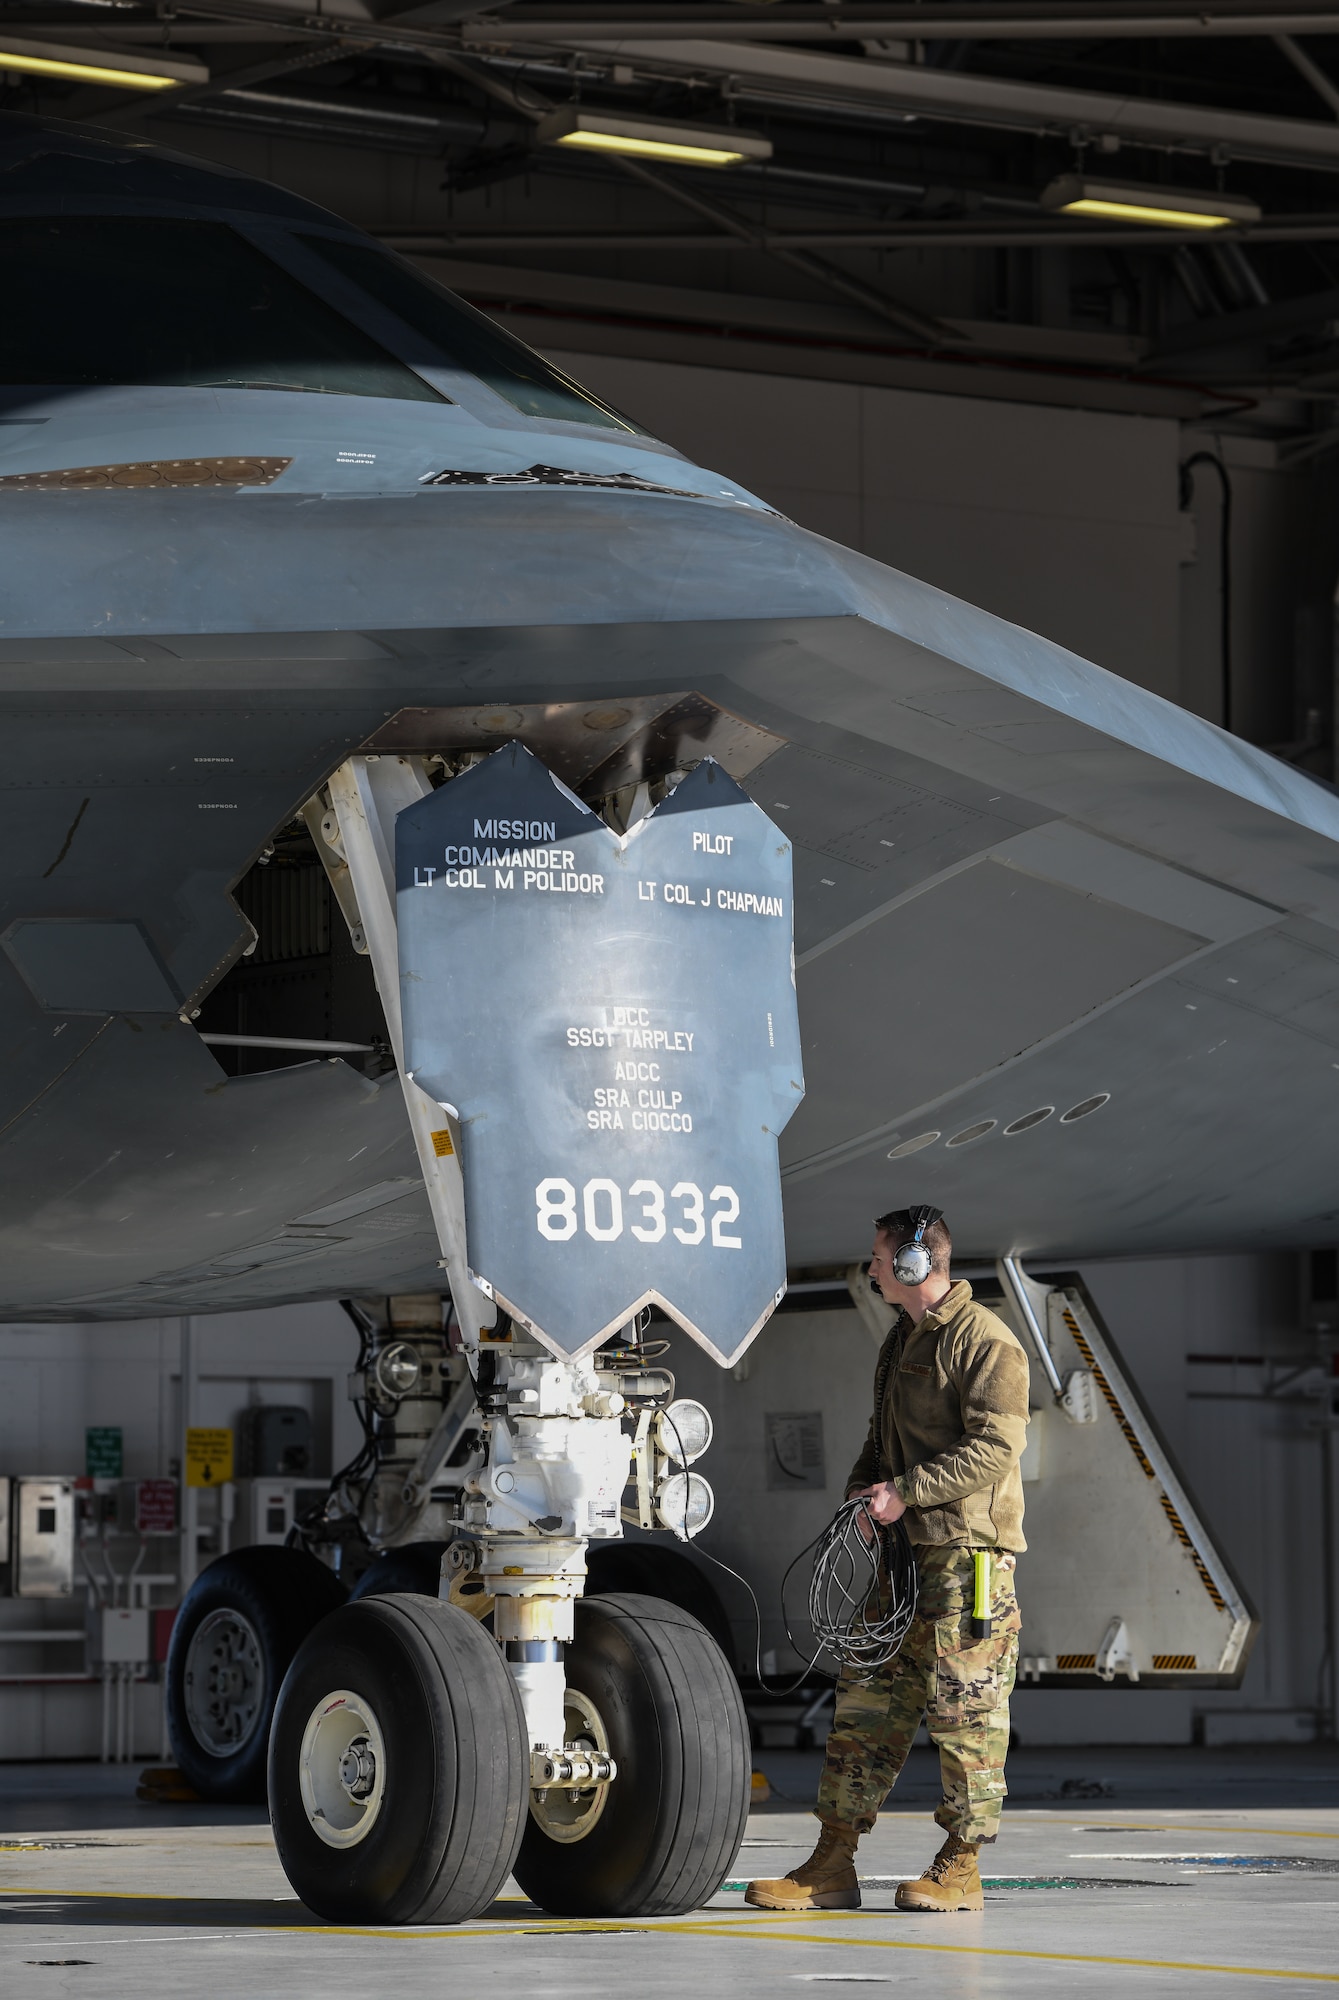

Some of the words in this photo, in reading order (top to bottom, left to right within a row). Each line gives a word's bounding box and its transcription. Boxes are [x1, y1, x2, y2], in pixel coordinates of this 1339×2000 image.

[473, 818, 556, 842] MISSION
[692, 831, 734, 855] PILOT
[444, 845, 575, 870] COMMANDER
[413, 866, 437, 887] LT
[445, 868, 487, 889] COL
[494, 869, 514, 890] M
[523, 871, 604, 894] POLIDOR
[638, 880, 657, 901] LT
[664, 883, 696, 905] COL
[701, 887, 711, 907] J
[717, 889, 783, 917] CHAPMAN
[566, 1027, 614, 1048] SSGT
[621, 1028, 694, 1052] TARPLEY
[614, 1061, 661, 1082] ADCC
[593, 1088, 631, 1108] SRA
[637, 1089, 683, 1110] CULP
[586, 1110, 624, 1130] SRA
[631, 1111, 693, 1133] CIOCCO
[535, 1177, 742, 1249] 80332
